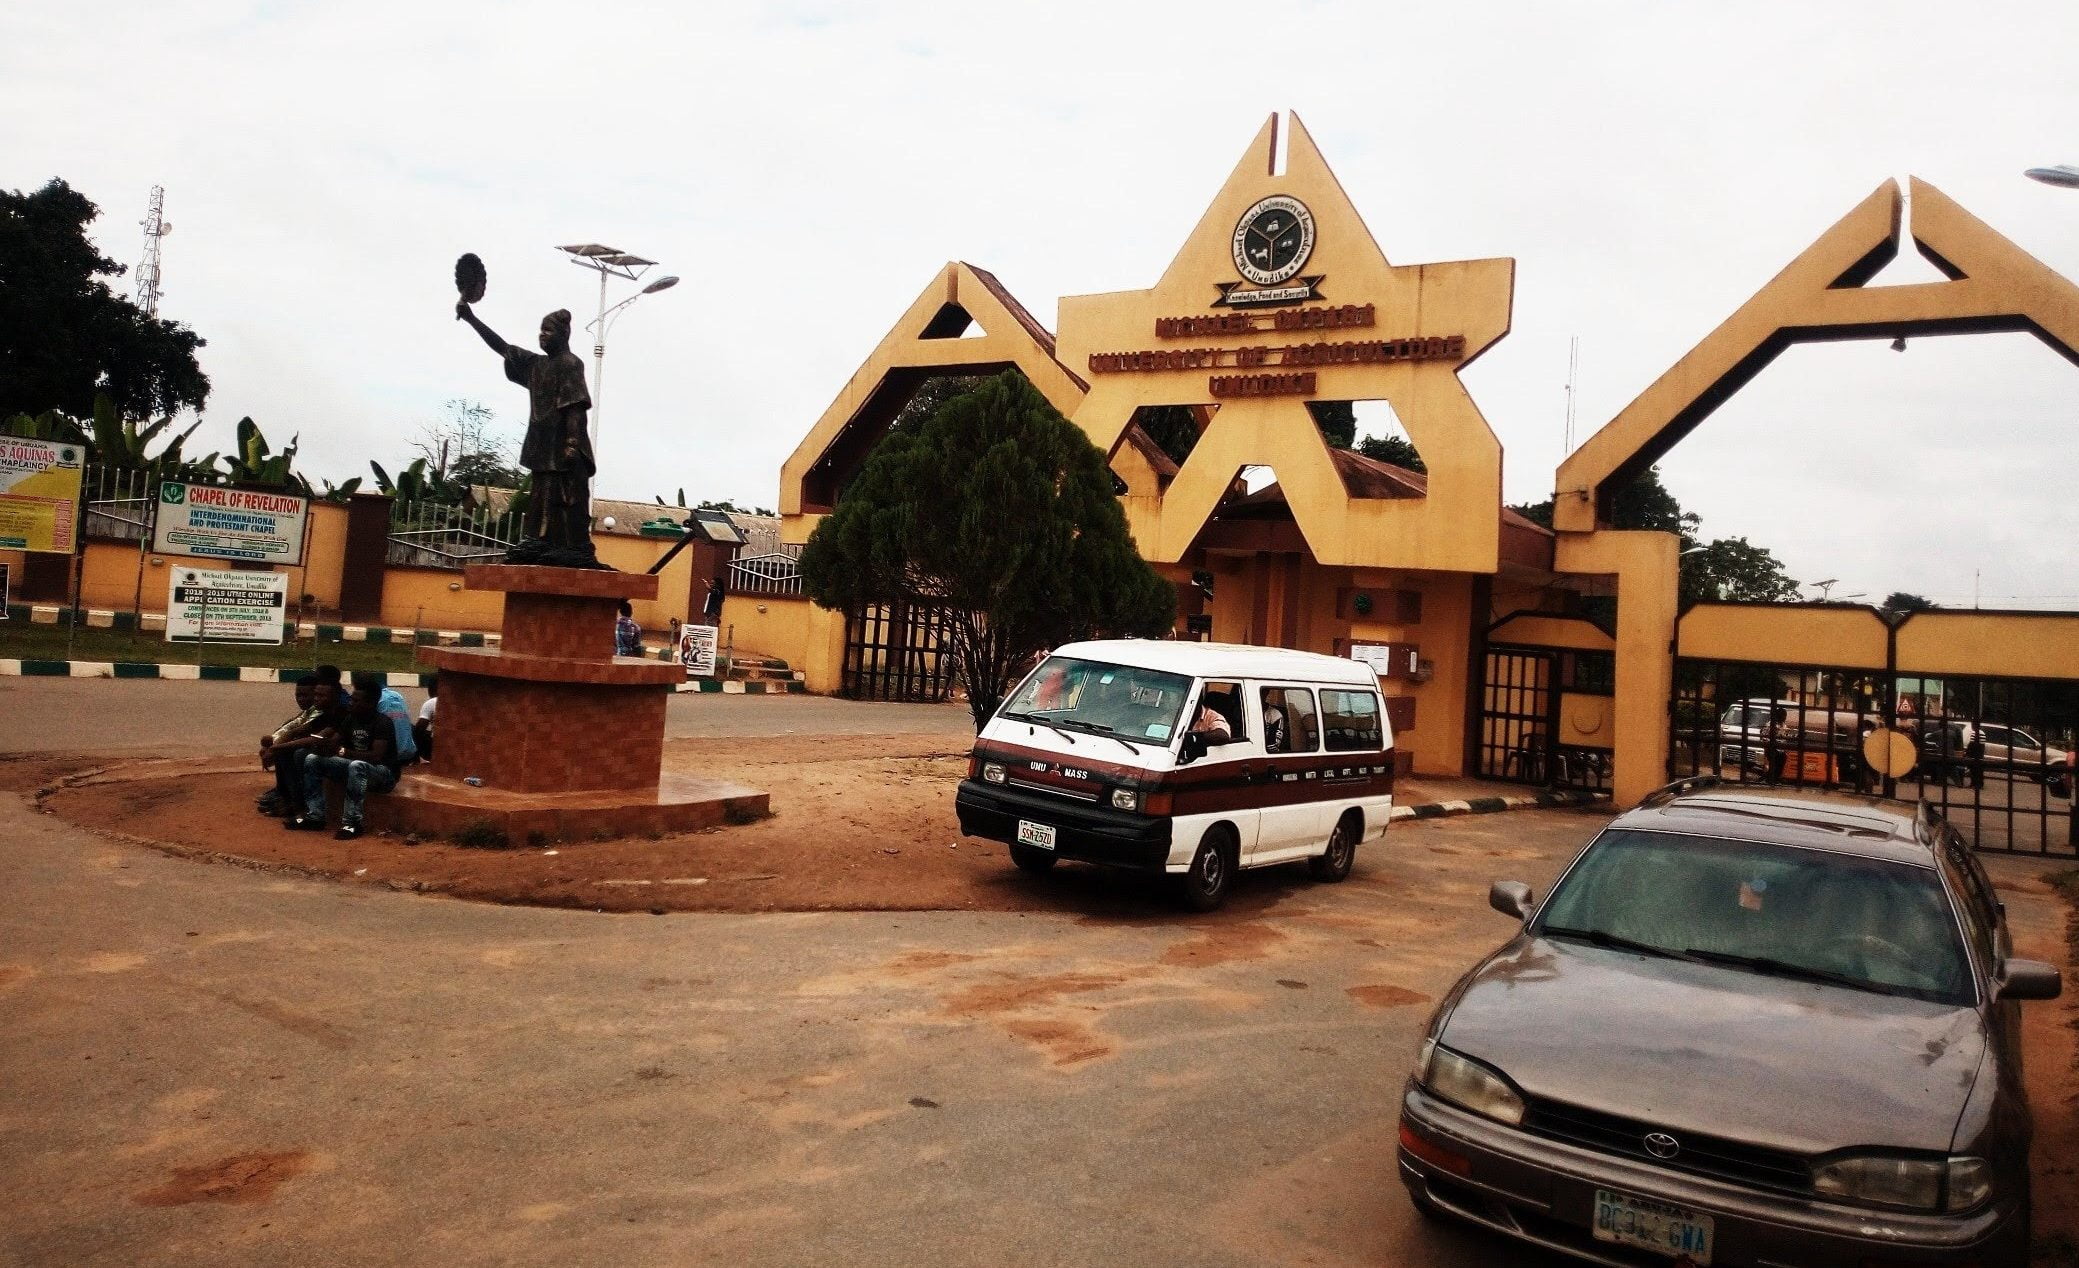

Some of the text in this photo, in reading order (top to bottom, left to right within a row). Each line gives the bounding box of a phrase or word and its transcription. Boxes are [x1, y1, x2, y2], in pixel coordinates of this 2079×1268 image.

[1089, 335, 1466, 373] UNIVERSITY OF AGRICULTURE
[9, 447, 55, 463] AQUINAS
[0, 458, 49, 471] HAPLAINCY
[190, 487, 301, 515] CHAPEL OF REVELATION
[190, 510, 276, 526] INTERDENOMINATIONAL
[189, 518, 276, 535] AND PROTESTANT CHAPEL
[236, 598, 275, 606] EXERCISE
